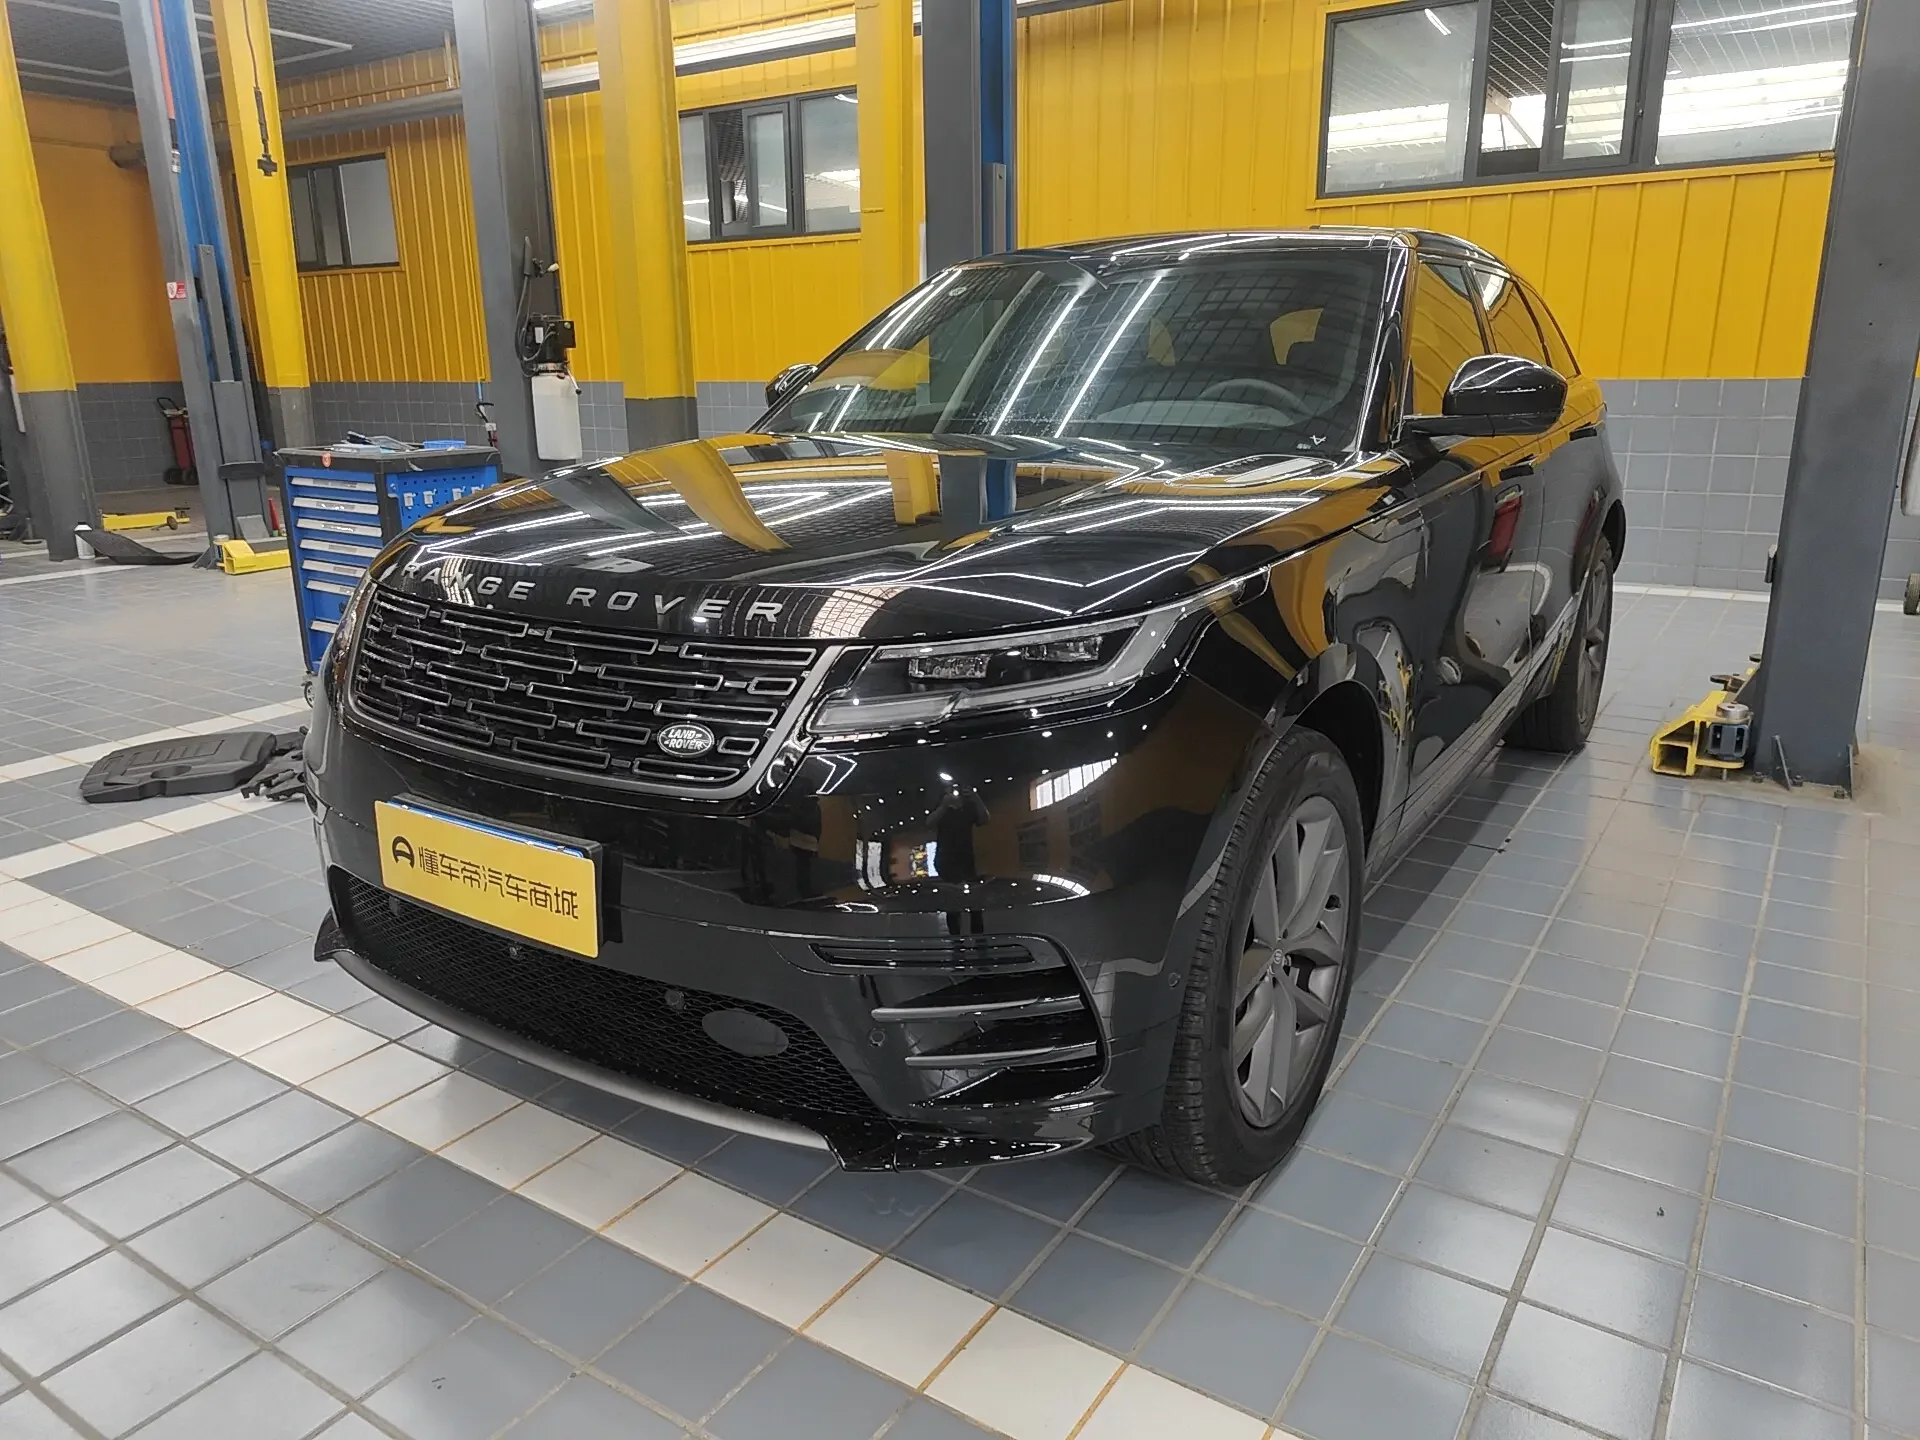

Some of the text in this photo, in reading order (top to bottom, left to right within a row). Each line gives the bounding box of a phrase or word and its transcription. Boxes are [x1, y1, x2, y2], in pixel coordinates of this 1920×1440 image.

[401, 561, 783, 622] RANGE ROVER
[668, 729, 696, 739] LAND
[669, 739, 703, 750] ROVER
[418, 846, 579, 919] 懂车帝汽车商城
